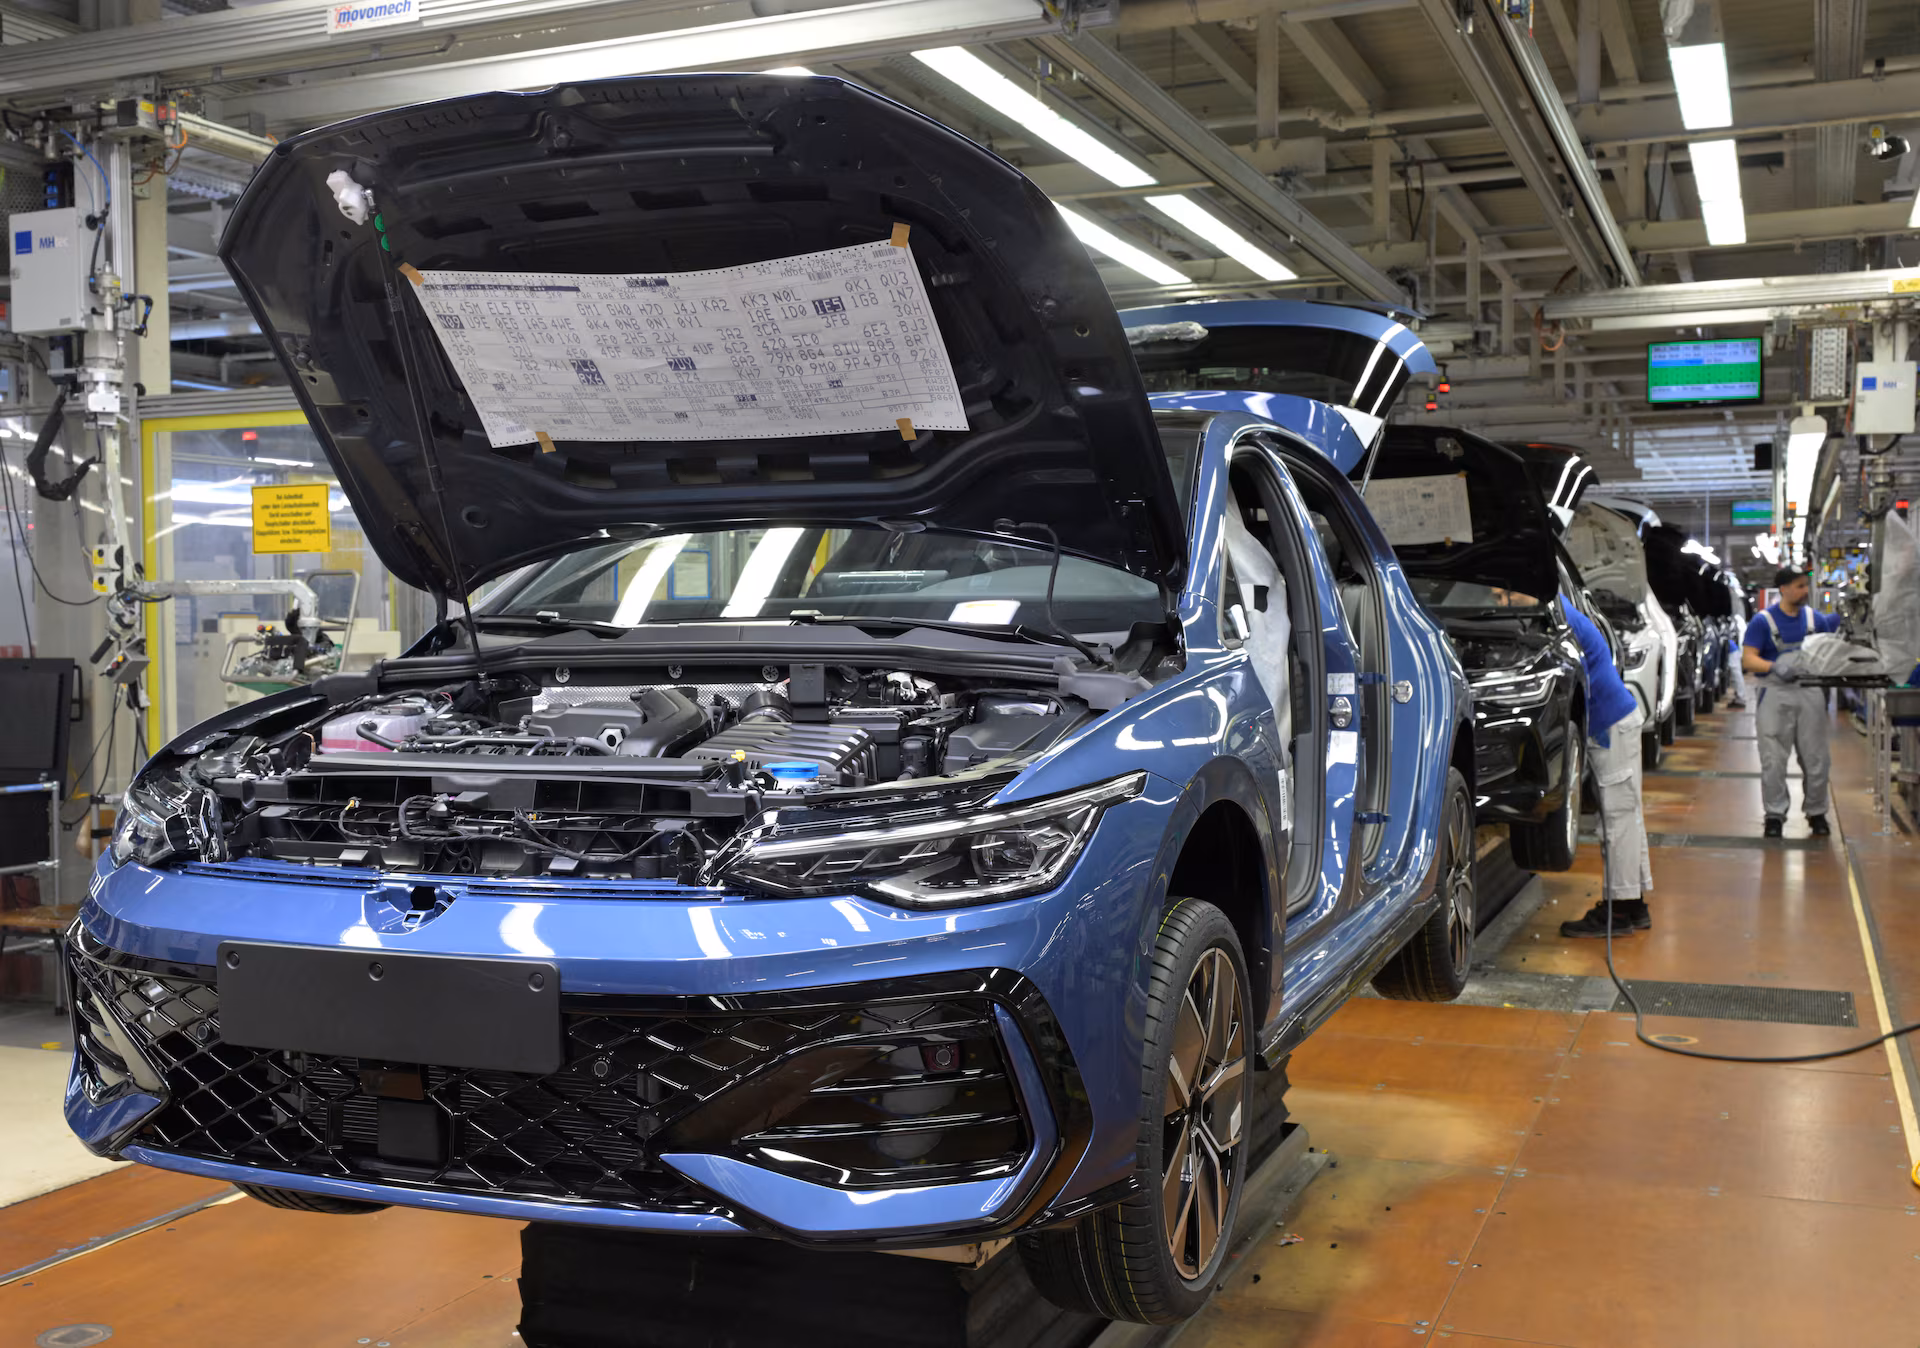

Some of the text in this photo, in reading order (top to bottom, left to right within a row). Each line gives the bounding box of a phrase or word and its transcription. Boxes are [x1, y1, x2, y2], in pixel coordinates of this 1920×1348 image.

[337, 0, 411, 23] movomech
[673, 301, 697, 315] J4J
[701, 299, 730, 312] KA2
[740, 293, 769, 308] KK3
[844, 278, 872, 293] QK1
[880, 271, 909, 287] QU3
[747, 308, 775, 323] 1AE
[850, 292, 879, 308] 1G8
[888, 286, 914, 303] 1N7
[652, 332, 680, 344] 2JX
[716, 328, 744, 341] 3A2
[752, 322, 781, 337] 3CA
[821, 314, 850, 329] 3FB
[893, 302, 923, 318] 3QH
[661, 345, 686, 357] 4L6
[692, 343, 716, 355] 4UF
[724, 341, 750, 354] 6C2
[863, 322, 890, 338] 6E3
[570, 360, 597, 372] 7L6
[666, 357, 696, 371] 7UY
[766, 351, 794, 364] 79H
[843, 357, 871, 371] 9P4
